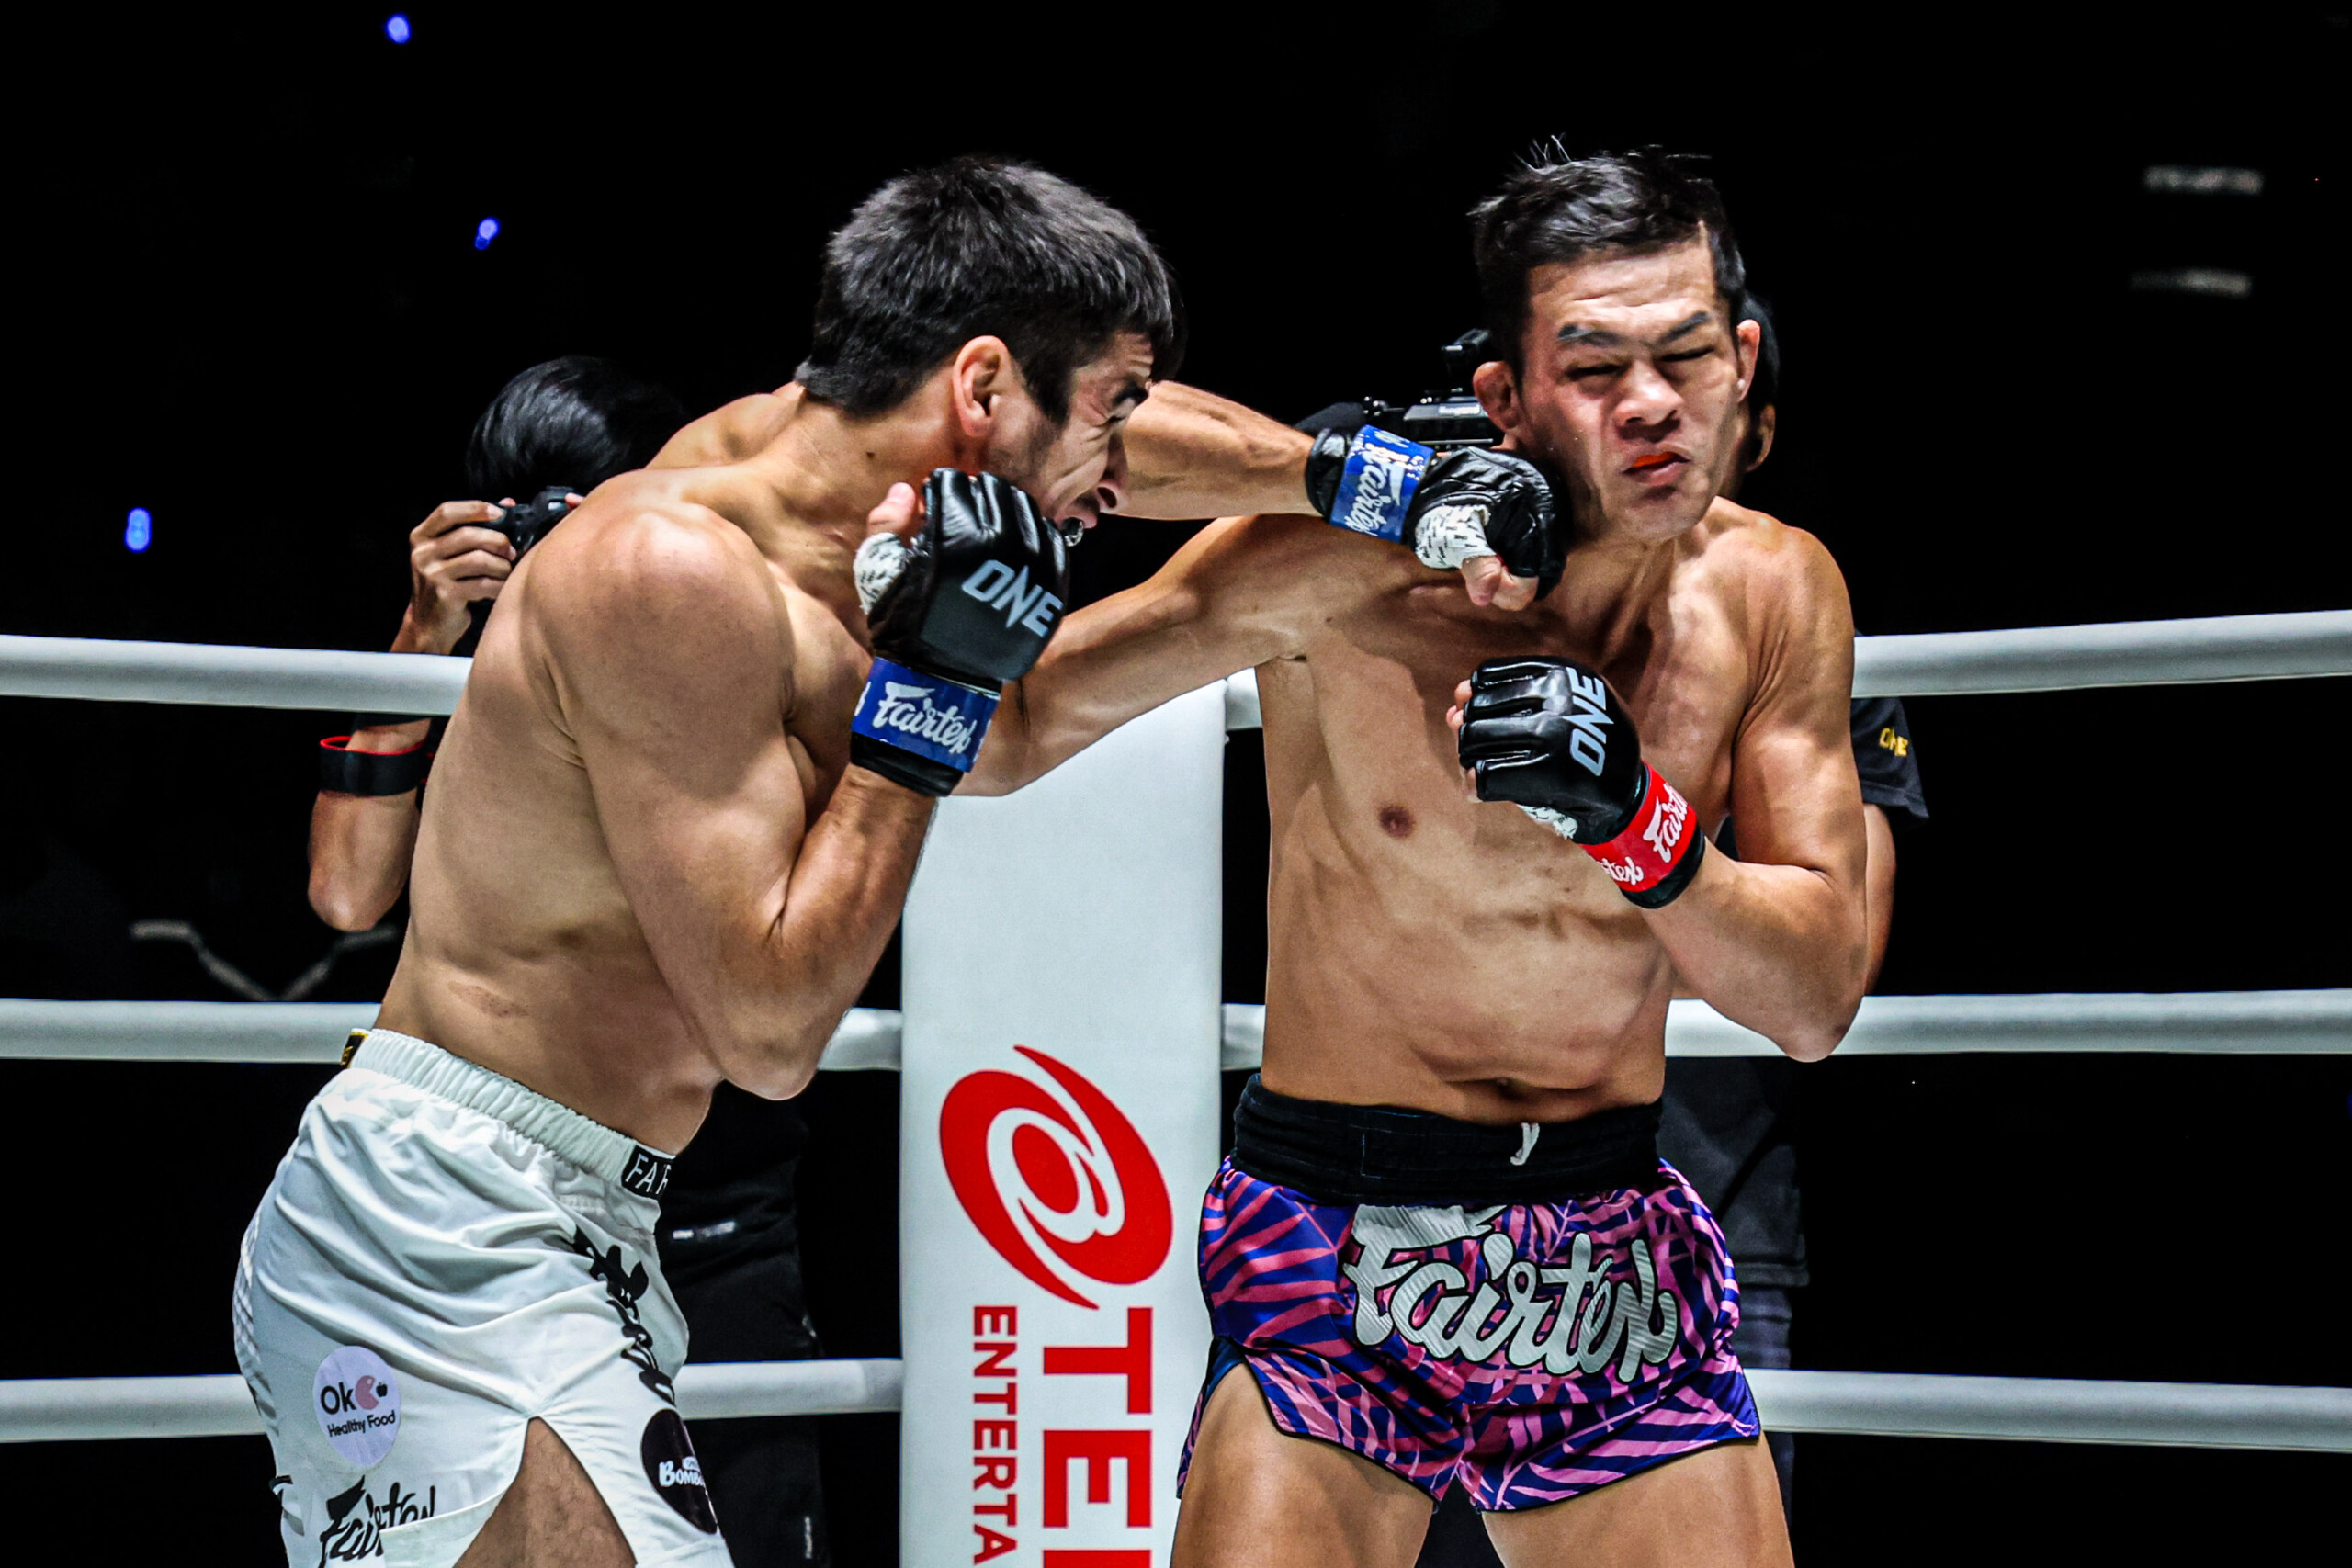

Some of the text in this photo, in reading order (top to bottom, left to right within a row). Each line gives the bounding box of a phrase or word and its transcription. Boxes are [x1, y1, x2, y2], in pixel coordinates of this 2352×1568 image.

[961, 559, 1064, 637] ONE
[872, 681, 978, 754] Fairtex
[1563, 667, 1614, 776] ONE
[1342, 1203, 1679, 1382] Fairtex
[327, 1410, 396, 1438] Healthy Food
[1042, 1307, 1153, 1568] TE
